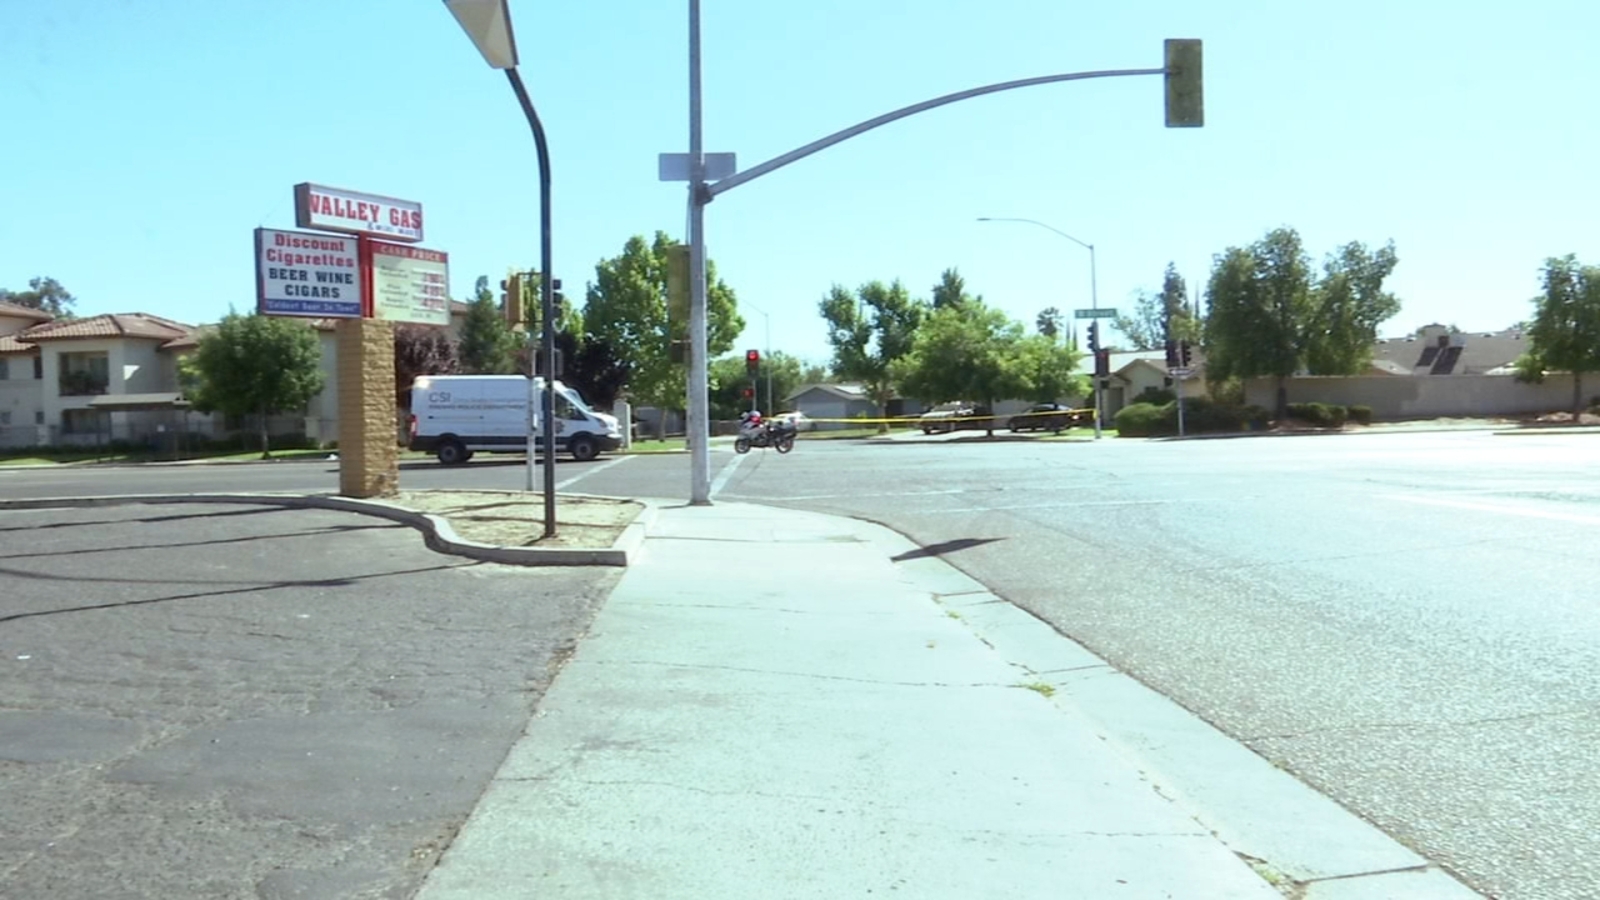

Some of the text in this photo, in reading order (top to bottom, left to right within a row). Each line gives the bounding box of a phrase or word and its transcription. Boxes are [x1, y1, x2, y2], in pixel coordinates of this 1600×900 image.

[309, 194, 422, 230] VALLEY GAS
[274, 233, 345, 252] Discount
[266, 248, 355, 267] Cigarettes
[380, 245, 441, 261] CASH PRICE
[269, 268, 354, 285] BEER WINE
[285, 284, 340, 298] CIGARS
[429, 392, 451, 403] CSI
